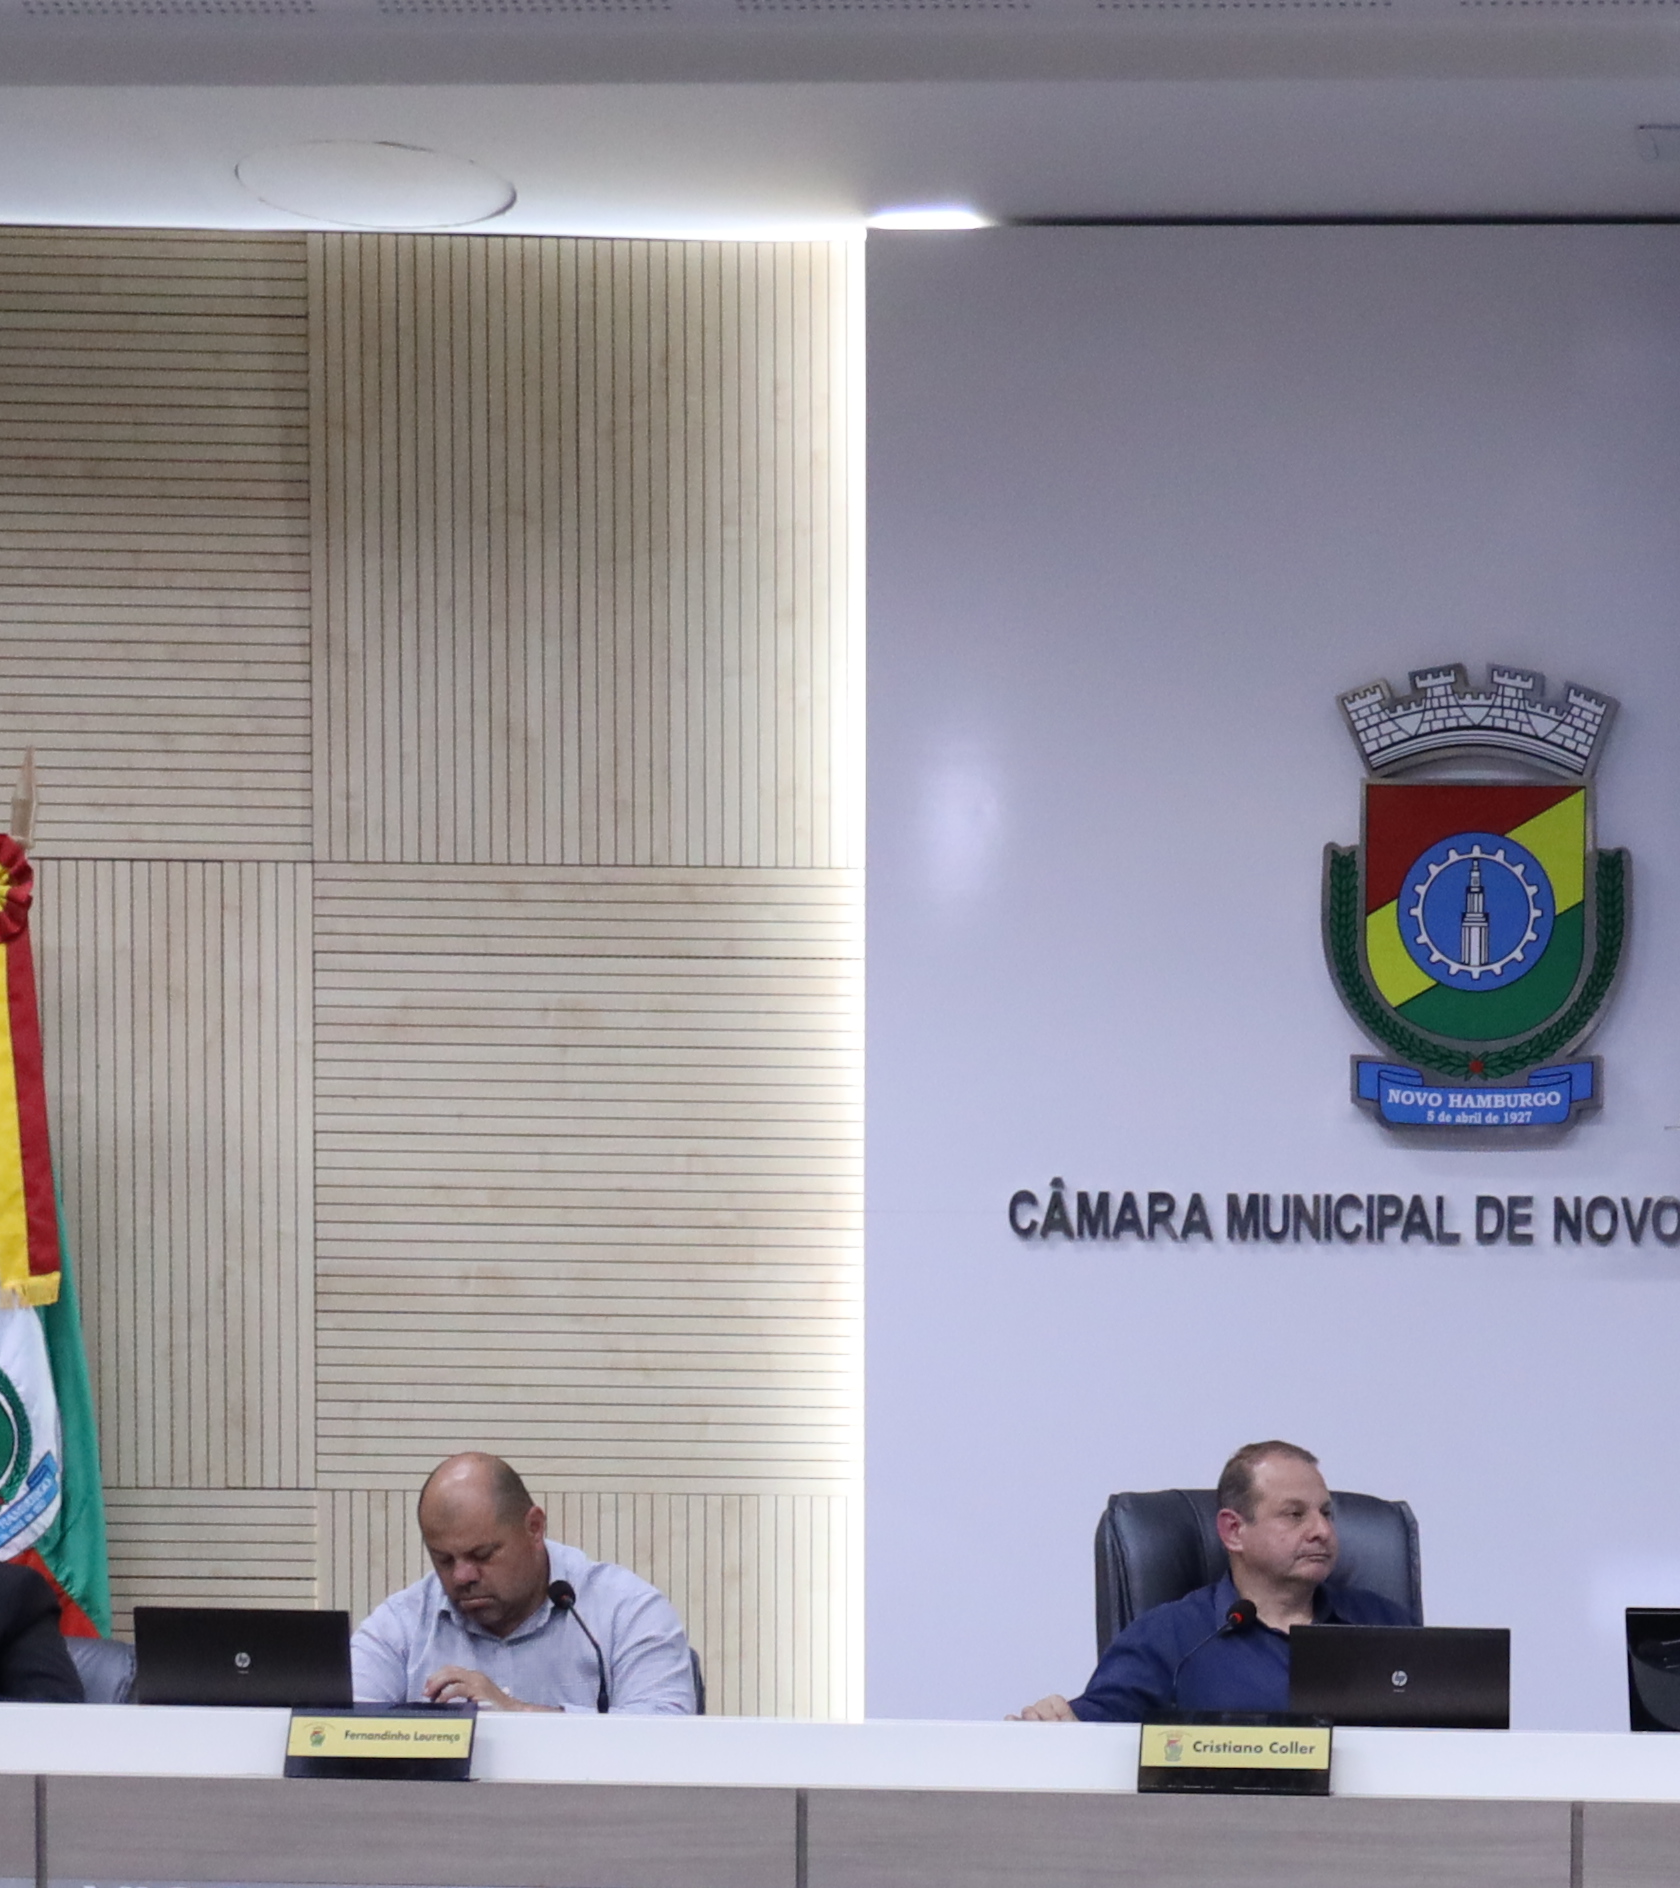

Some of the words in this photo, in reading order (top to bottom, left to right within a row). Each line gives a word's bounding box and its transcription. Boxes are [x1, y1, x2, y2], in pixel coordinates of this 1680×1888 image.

[1388, 1089, 1442, 1107] NOVO
[1449, 1091, 1560, 1108] HAMBURGO
[1427, 1110, 1434, 1121] 5
[1438, 1111, 1452, 1122] de
[1455, 1112, 1481, 1124] abril
[1485, 1112, 1499, 1123] de
[1504, 1111, 1532, 1123] 1927
[1009, 1177, 1213, 1242] CÂMARA
[1227, 1193, 1460, 1246] MUNICIPAL
[1476, 1196, 1533, 1246] DE
[345, 1730, 410, 1741] Fernandinho
[414, 1732, 460, 1743] Lourenço
[1193, 1741, 1263, 1753] Cristiano
[1269, 1741, 1315, 1754] Coller
